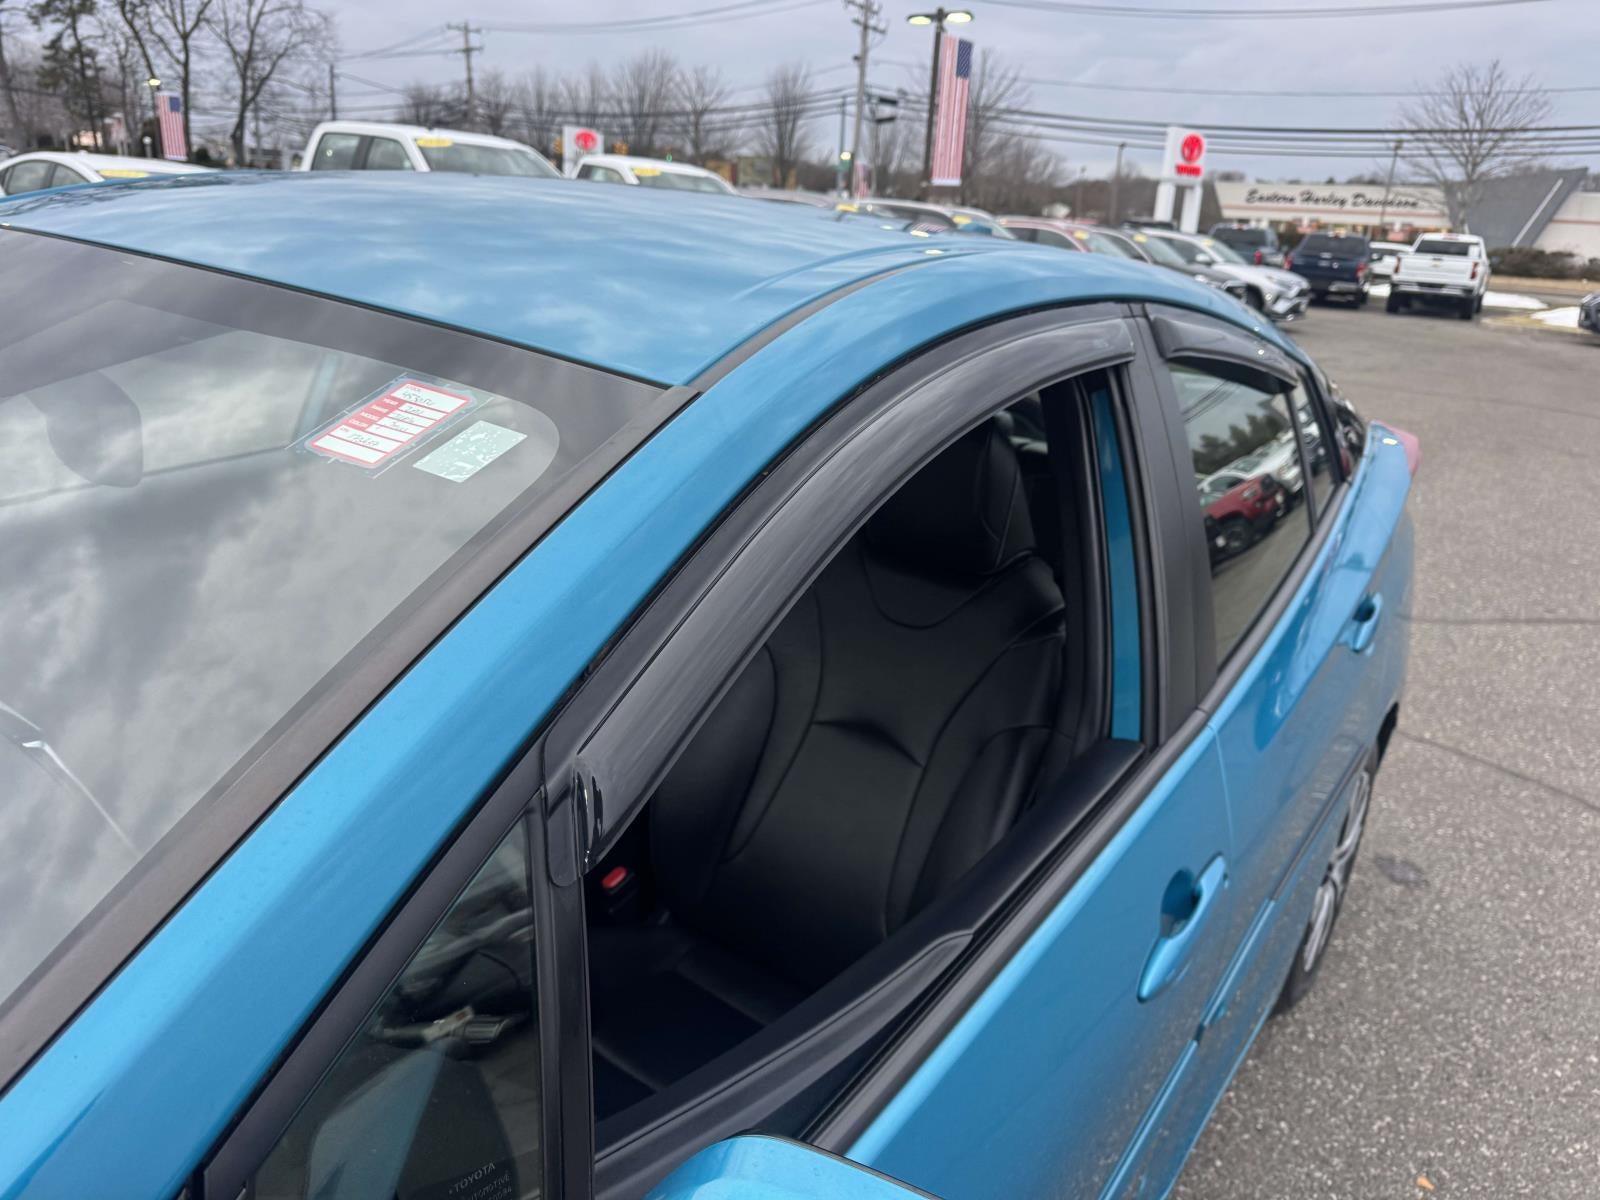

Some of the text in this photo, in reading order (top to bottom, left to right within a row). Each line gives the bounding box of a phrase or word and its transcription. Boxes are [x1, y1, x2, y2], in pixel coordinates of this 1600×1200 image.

[1246, 187, 1296, 204] Eastern
[1299, 189, 1347, 208] Harley
[454, 1162, 496, 1193] TOYOTA
